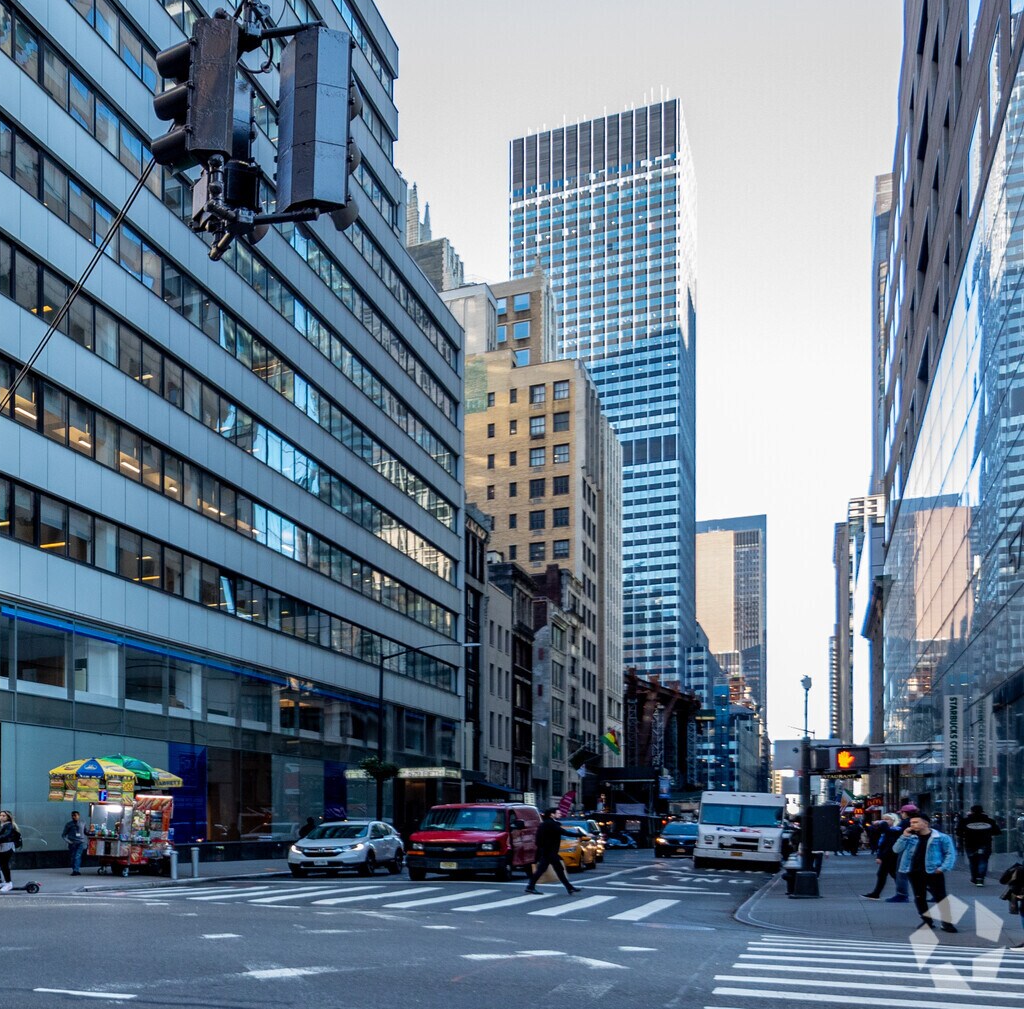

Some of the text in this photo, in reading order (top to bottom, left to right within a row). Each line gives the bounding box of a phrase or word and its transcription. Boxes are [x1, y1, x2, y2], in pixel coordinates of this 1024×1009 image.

[949, 696, 958, 767] STARBUCKS COFFEE
[716, 826, 762, 834] FedEx
